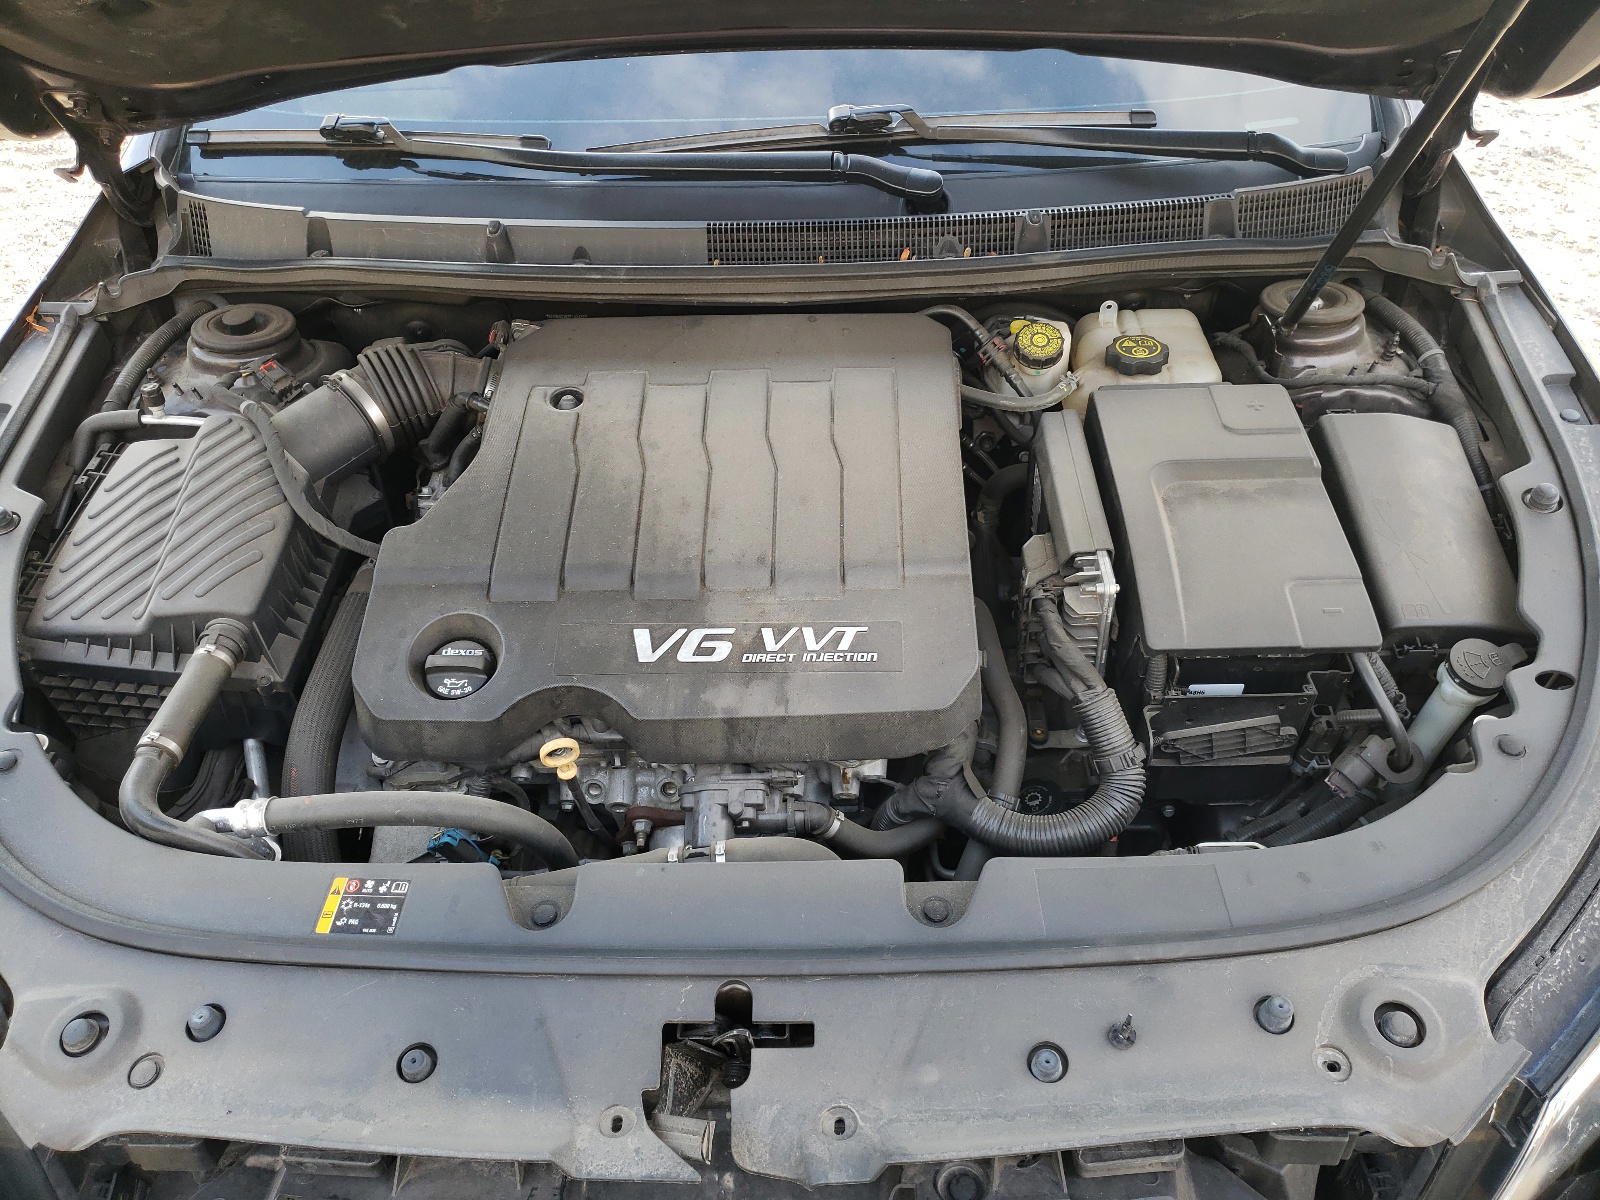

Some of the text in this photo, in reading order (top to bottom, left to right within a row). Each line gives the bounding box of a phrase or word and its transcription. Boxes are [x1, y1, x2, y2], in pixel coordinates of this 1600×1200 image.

[633, 627, 869, 663] V6 VVT
[442, 648, 484, 656] dexos
[742, 652, 878, 663] DIRECT INJECTION
